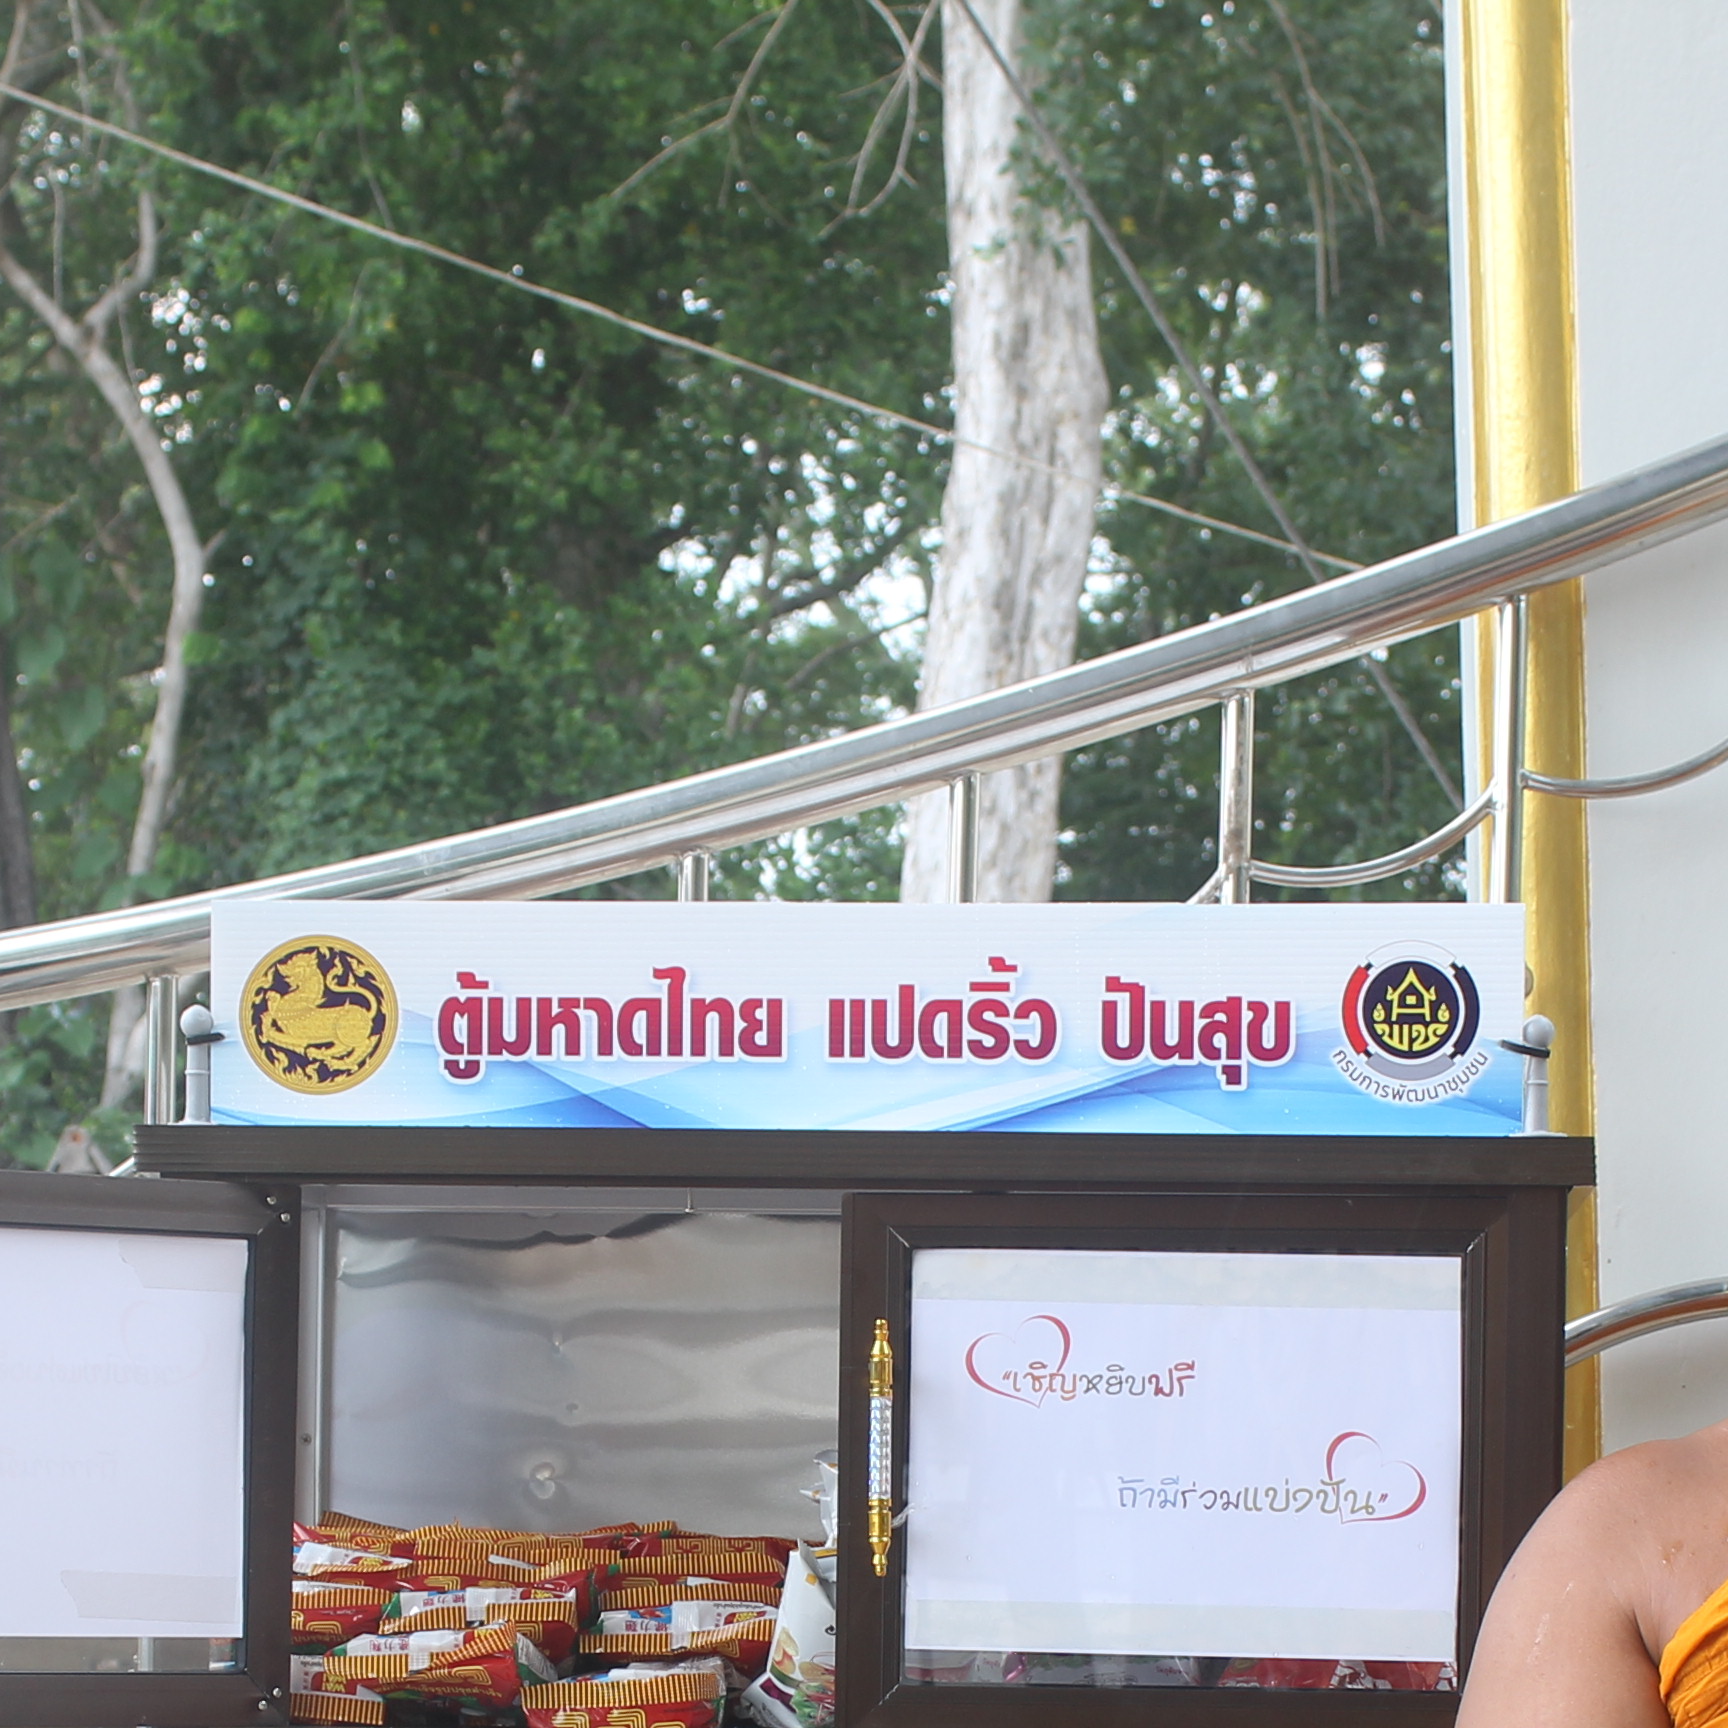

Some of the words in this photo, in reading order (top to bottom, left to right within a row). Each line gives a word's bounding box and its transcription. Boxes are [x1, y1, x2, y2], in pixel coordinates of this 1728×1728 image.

[437, 966, 783, 1080] ตู้มหาดไทย
[827, 956, 1058, 1063] แปดริ้ว
[1100, 974, 1290, 1086] ปันสุข
[1332, 1049, 1489, 1103] กรมการพัฒนาชุมชน
